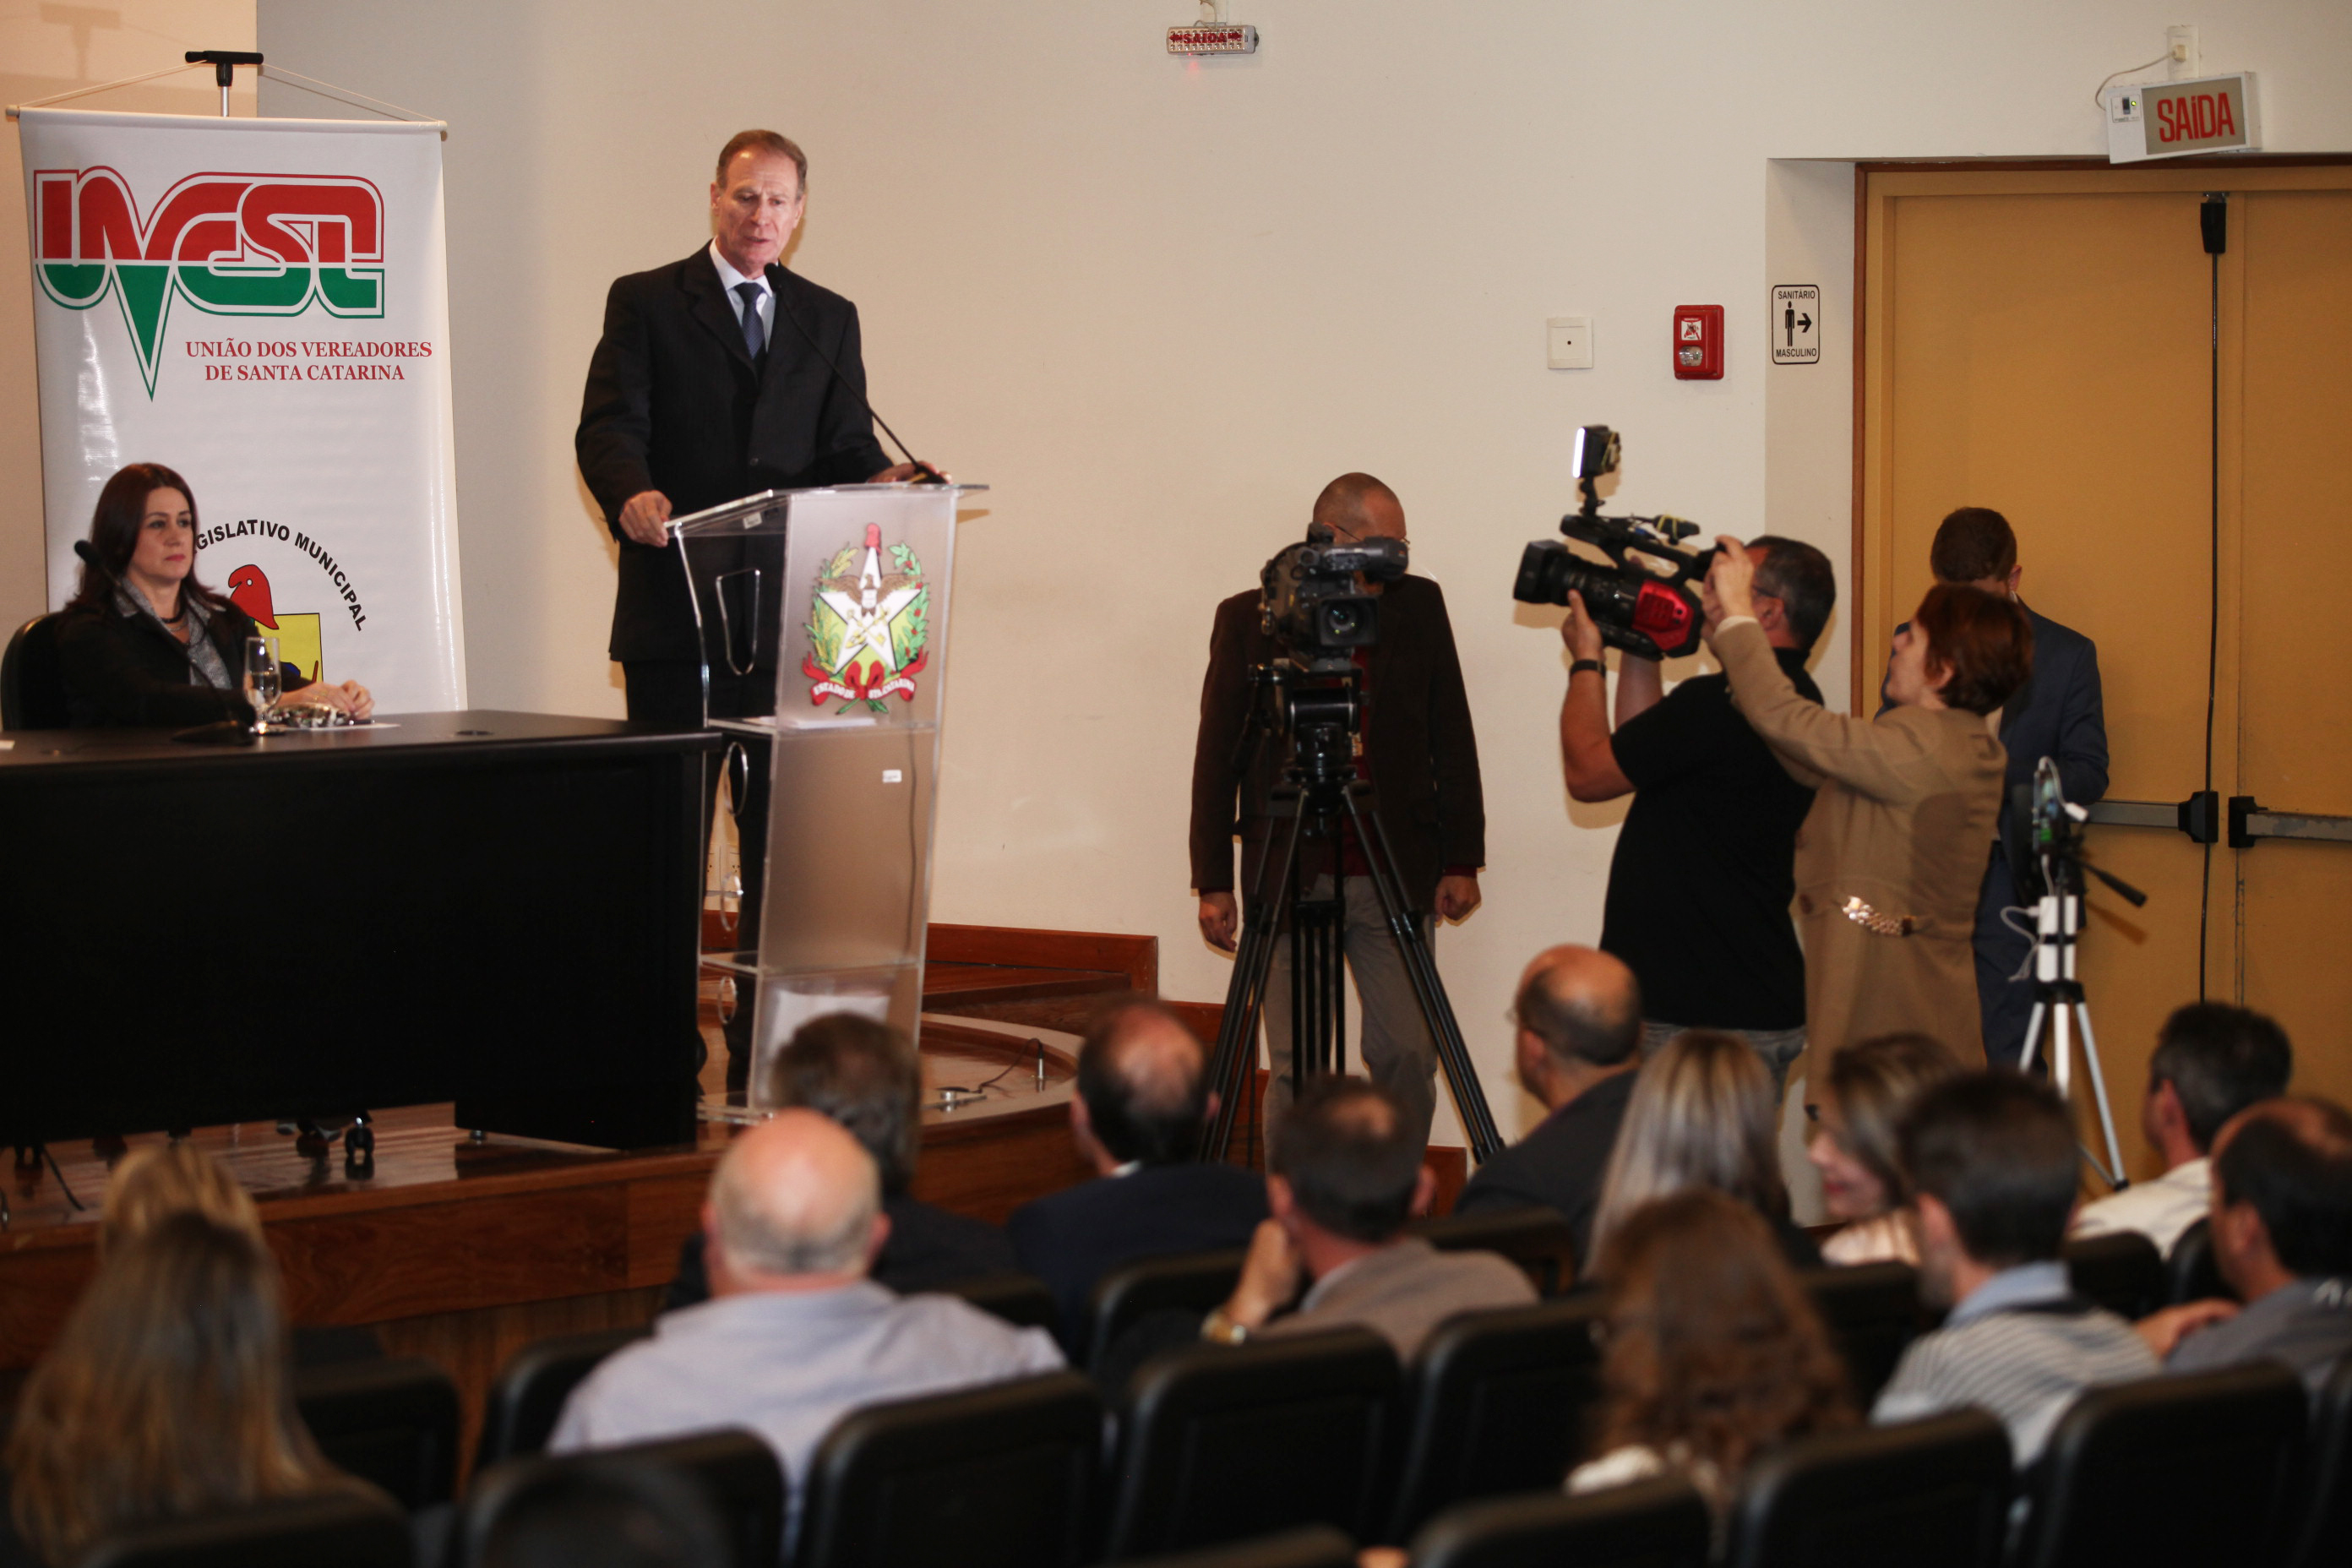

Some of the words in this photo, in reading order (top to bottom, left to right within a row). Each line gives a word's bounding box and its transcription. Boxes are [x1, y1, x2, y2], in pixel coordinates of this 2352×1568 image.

[1778, 289, 1816, 299] SANITÁRIO
[185, 338, 253, 357] UNIÃO
[256, 341, 297, 357] DOS
[301, 341, 433, 357] VEREADORES
[1776, 347, 1817, 357] MASCULINO
[204, 365, 233, 381] DE
[237, 365, 302, 381] SANTA
[307, 365, 406, 381] CATARINA
[295, 532, 367, 632] MUNICIPAL
